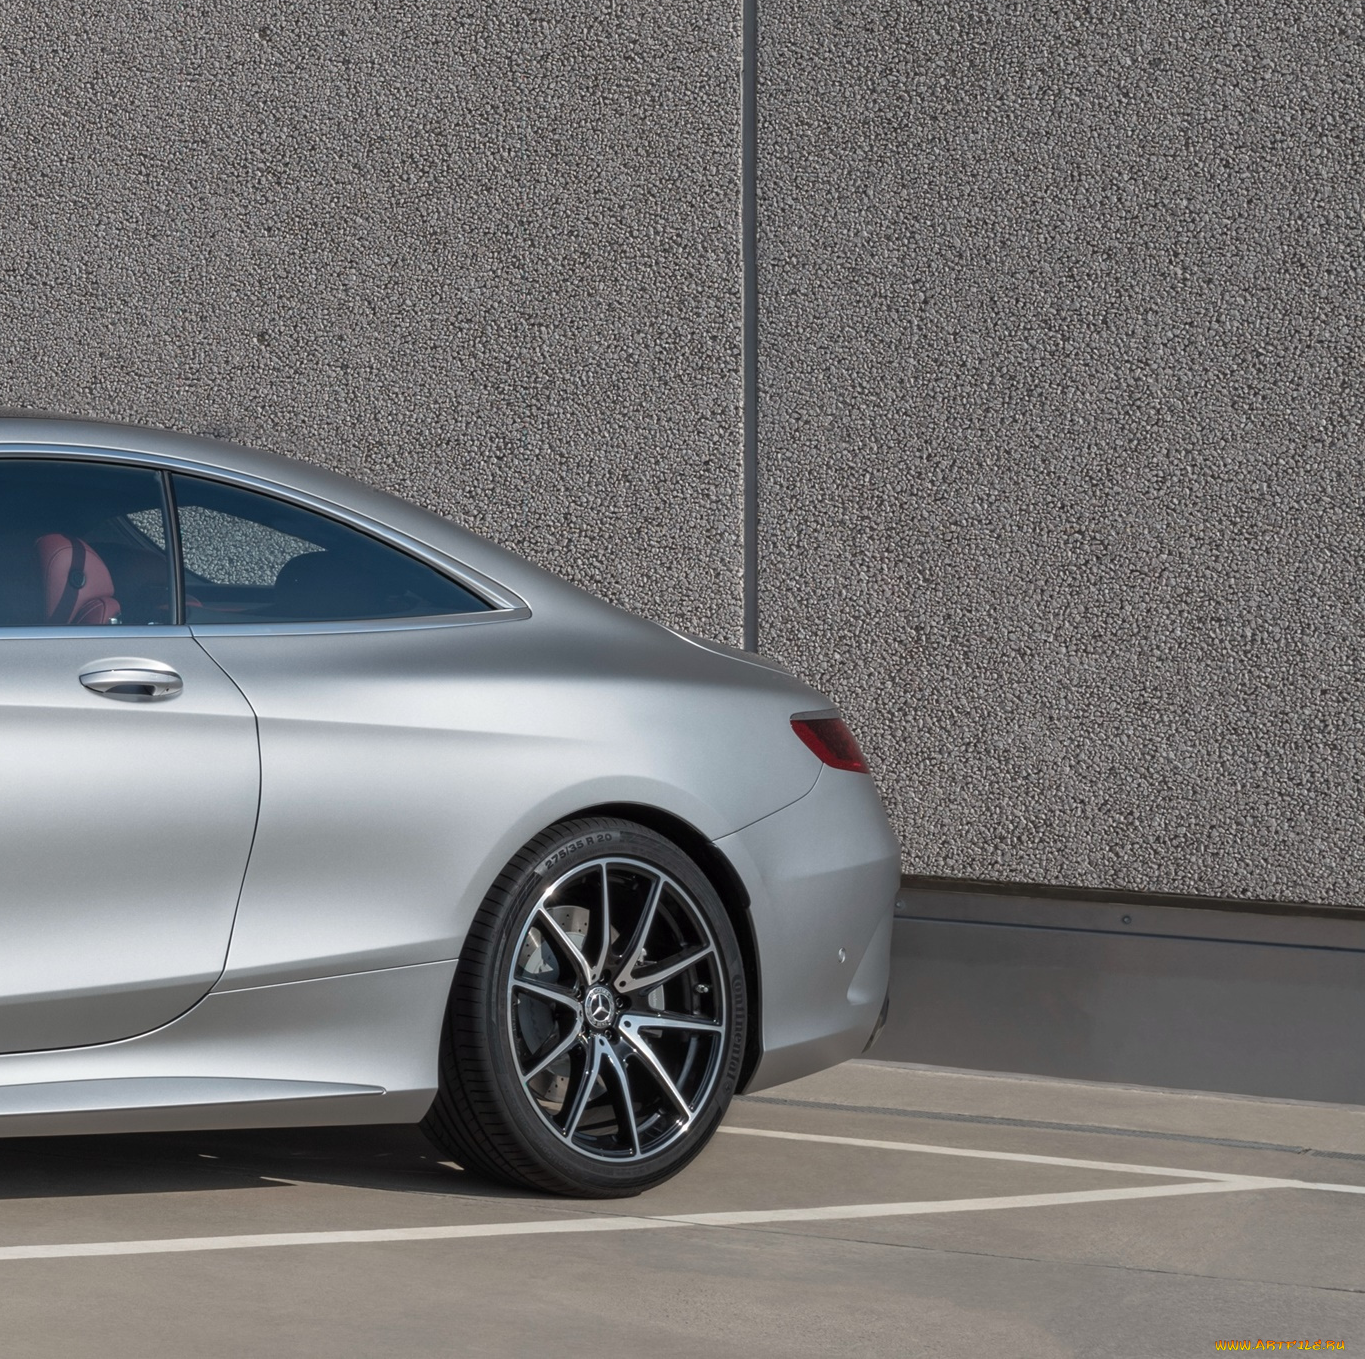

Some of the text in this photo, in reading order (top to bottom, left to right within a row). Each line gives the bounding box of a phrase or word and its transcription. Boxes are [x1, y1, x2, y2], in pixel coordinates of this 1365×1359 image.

[545, 833, 612, 870] 275/35 R 20
[726, 974, 743, 1081] Continental
